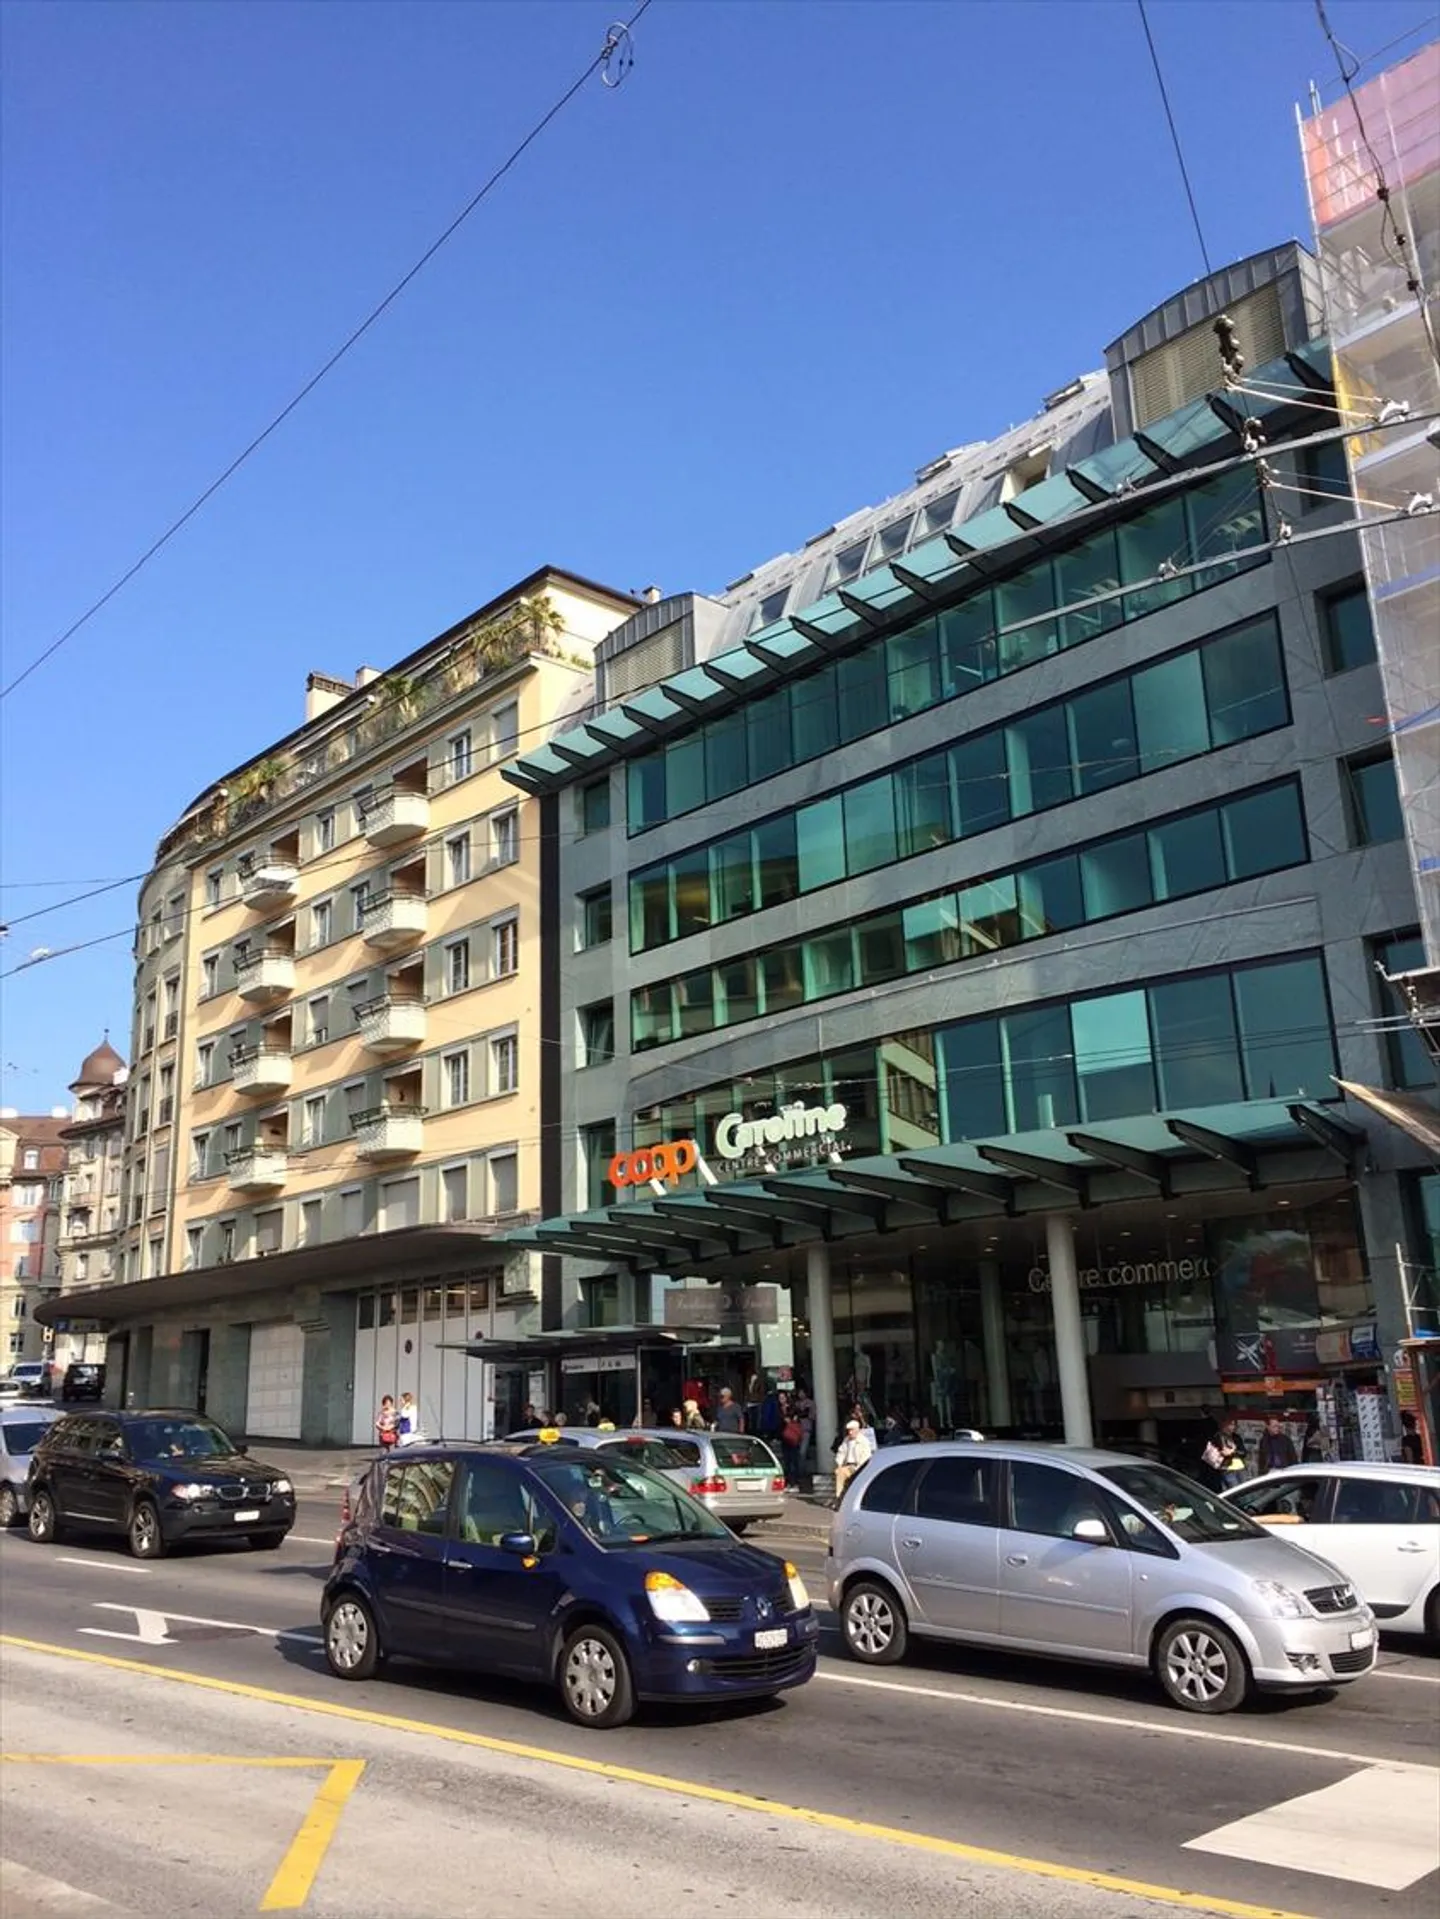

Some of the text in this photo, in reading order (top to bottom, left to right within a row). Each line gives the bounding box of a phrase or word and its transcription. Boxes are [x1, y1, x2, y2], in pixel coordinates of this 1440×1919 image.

[716, 1101, 847, 1159] Caroline
[608, 1139, 697, 1187] coop
[716, 1141, 847, 1174] CENTRE COMMERCIAL
[1028, 1267, 1101, 1293] Cere
